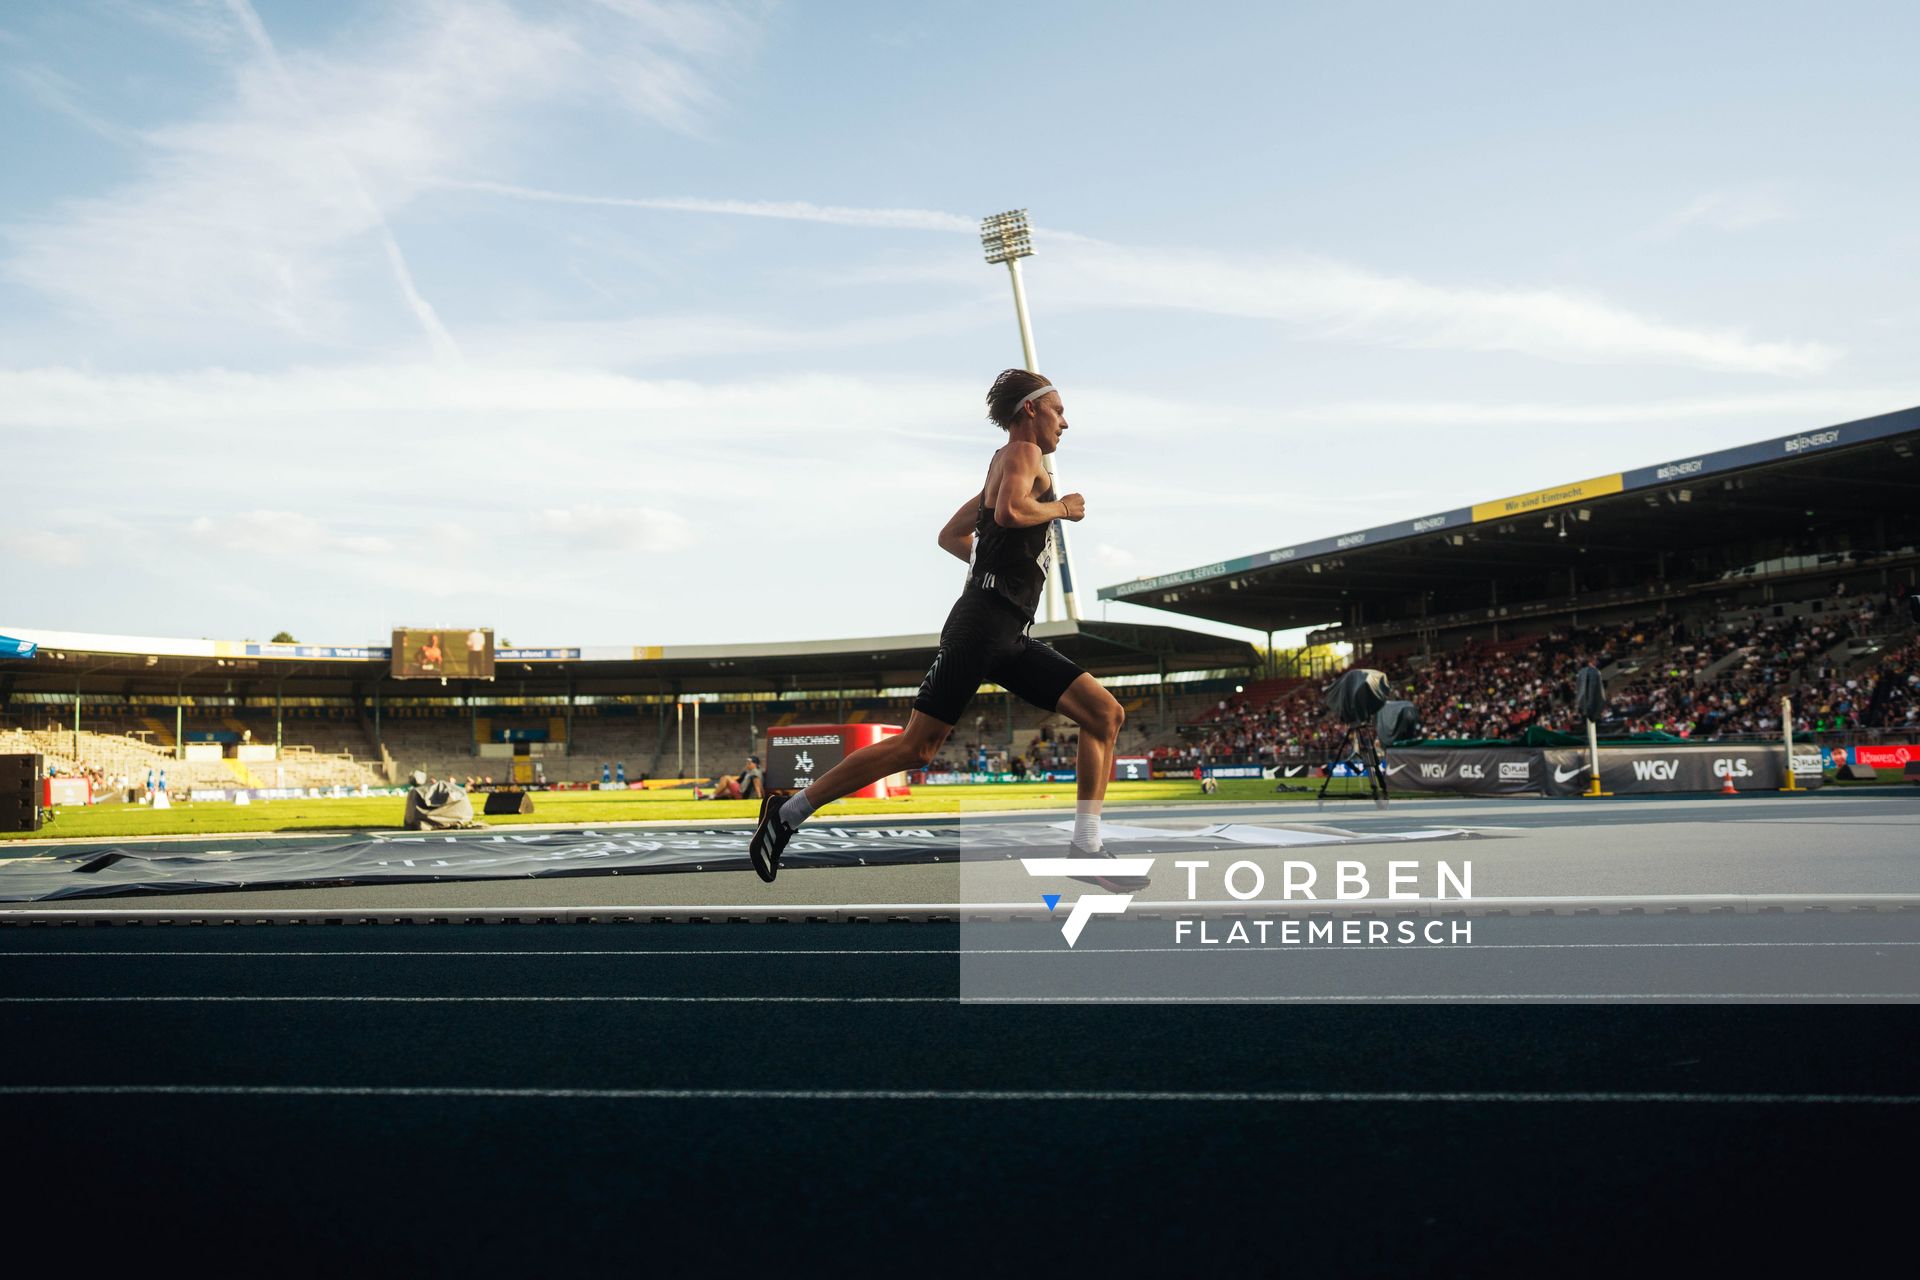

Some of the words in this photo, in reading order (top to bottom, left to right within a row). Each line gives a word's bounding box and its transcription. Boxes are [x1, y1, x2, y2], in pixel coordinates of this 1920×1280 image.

[1505, 503, 1519, 511] Wir
[1521, 497, 1540, 508] sind
[773, 735, 840, 746] BRAUNSCHWEIG
[1420, 763, 1447, 778] WGV
[1632, 759, 1679, 781] WGV
